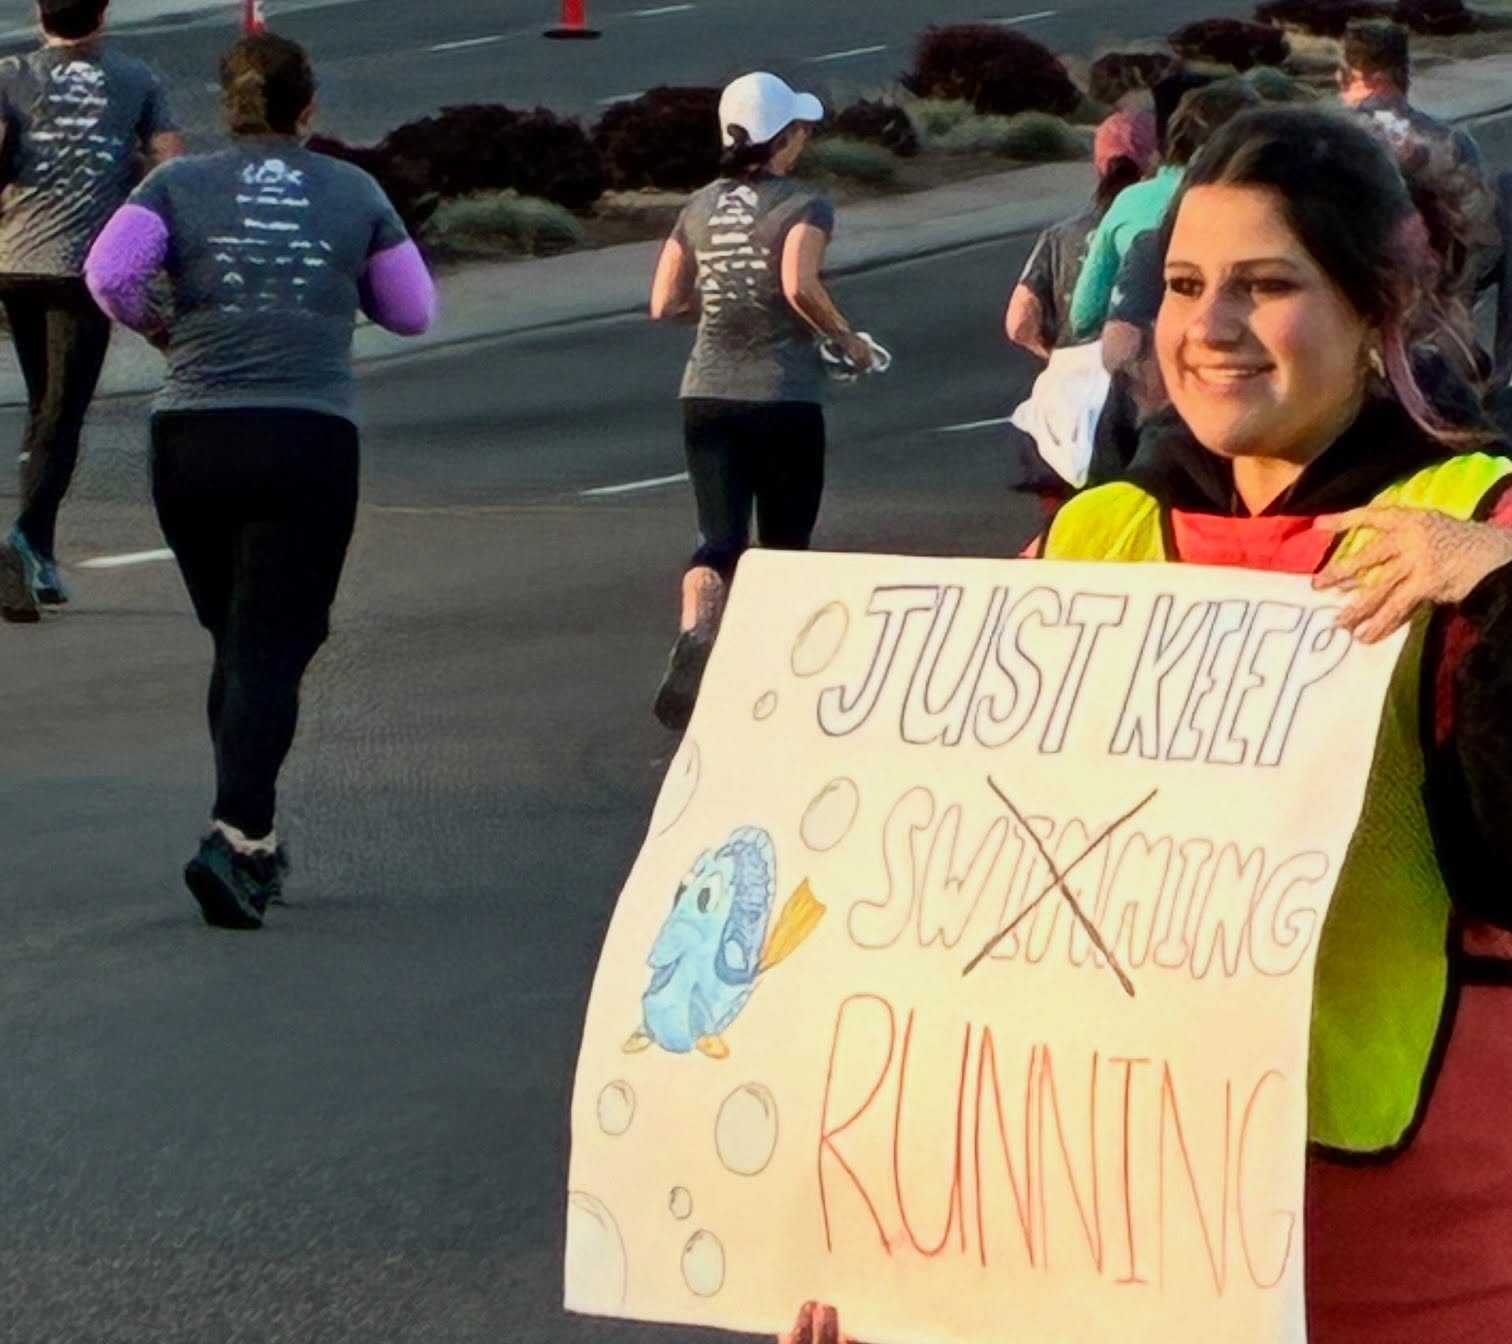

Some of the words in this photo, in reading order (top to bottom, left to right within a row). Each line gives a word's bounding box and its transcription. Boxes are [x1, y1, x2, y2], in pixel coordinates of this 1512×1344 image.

[816, 585, 1129, 754] JUST
[1108, 593, 1353, 767] KEEP
[847, 785, 1330, 979] SWIMMING
[817, 993, 1298, 1298] RUNNING
